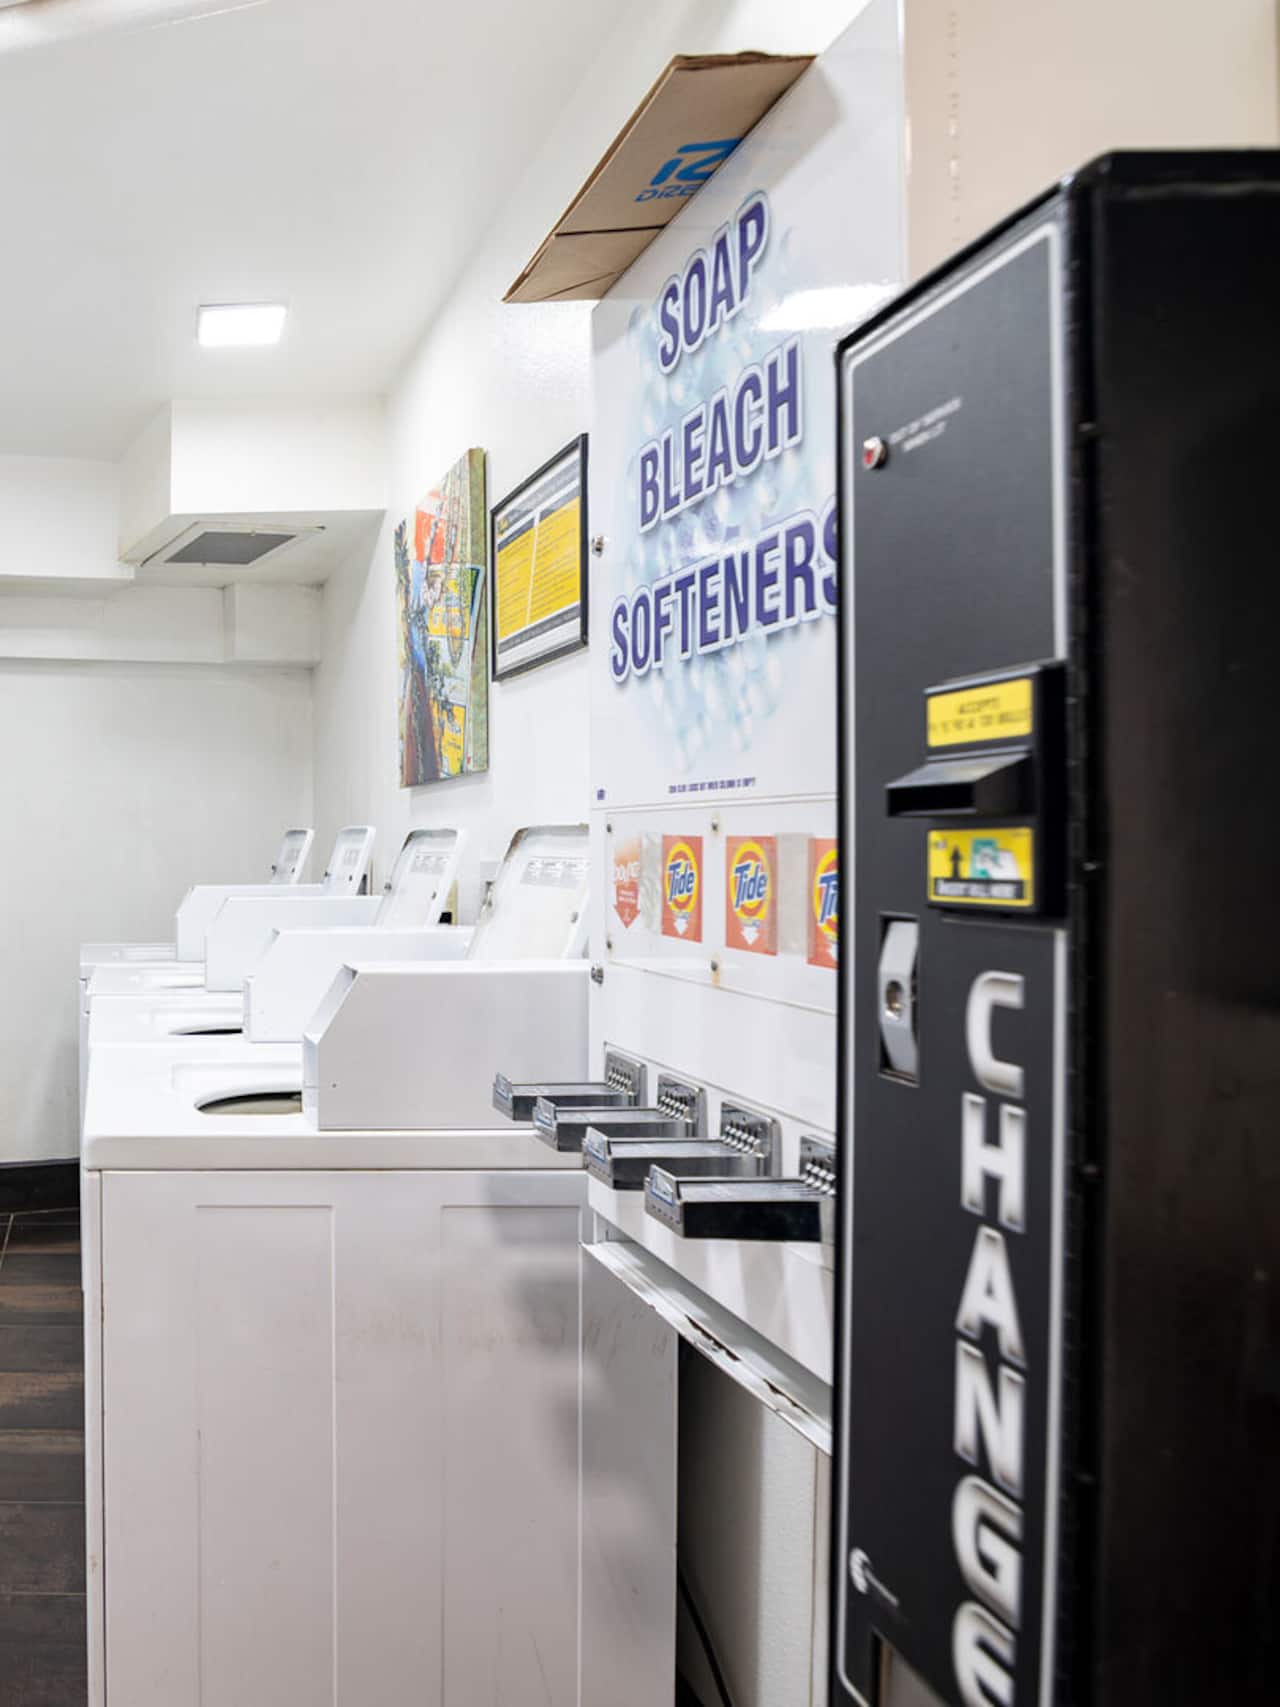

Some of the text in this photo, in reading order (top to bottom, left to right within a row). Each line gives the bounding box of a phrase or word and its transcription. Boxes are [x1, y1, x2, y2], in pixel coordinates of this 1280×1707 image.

[659, 197, 767, 370] SOAP
[639, 343, 802, 530] BLEACH
[668, 860, 695, 903] Tide
[734, 862, 768, 909] Tide
[819, 873, 837, 924] Ti
[952, 970, 1027, 1707] CHANGE
